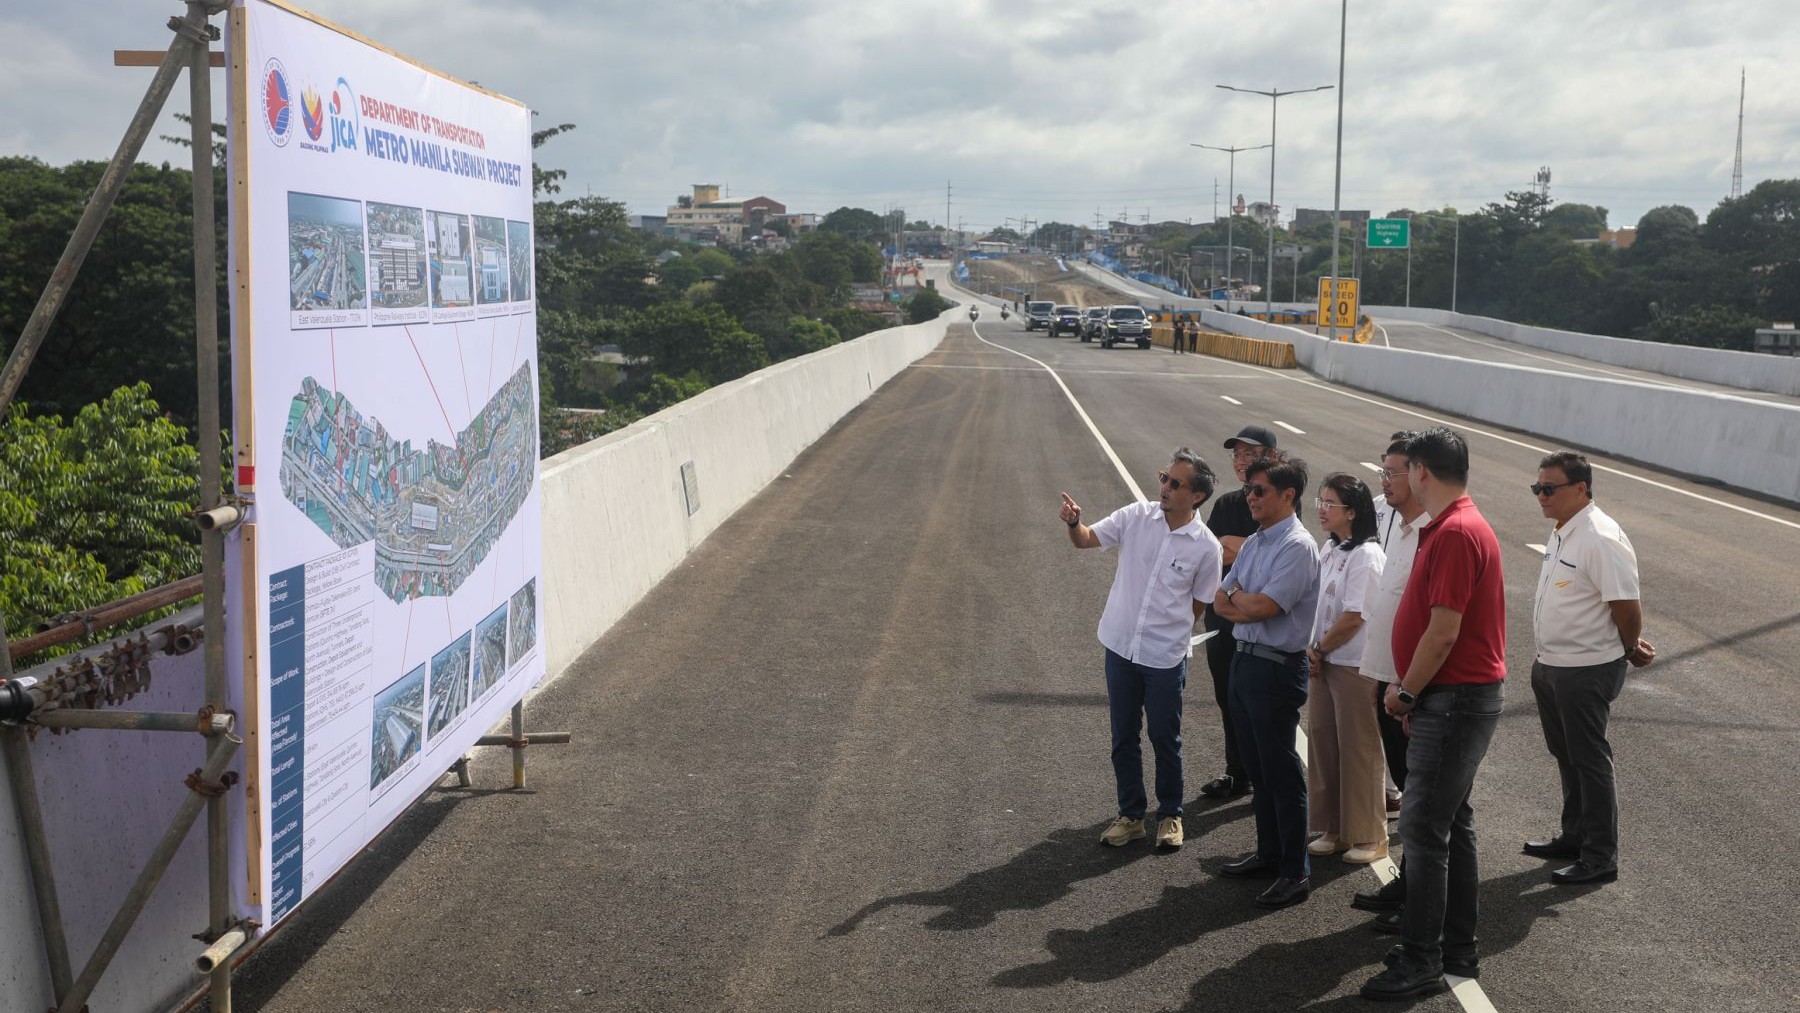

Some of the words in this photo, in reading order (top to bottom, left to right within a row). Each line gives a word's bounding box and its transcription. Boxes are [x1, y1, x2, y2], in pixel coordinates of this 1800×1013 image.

[360, 94, 419, 131] DEPARTMENT
[421, 114, 431, 133] OF
[432, 117, 486, 150] TRANSPORTATION
[364, 126, 409, 164] METRO
[410, 138, 452, 173] MANILA
[451, 148, 486, 180] SUBWAY
[487, 158, 521, 187] PROJECT
